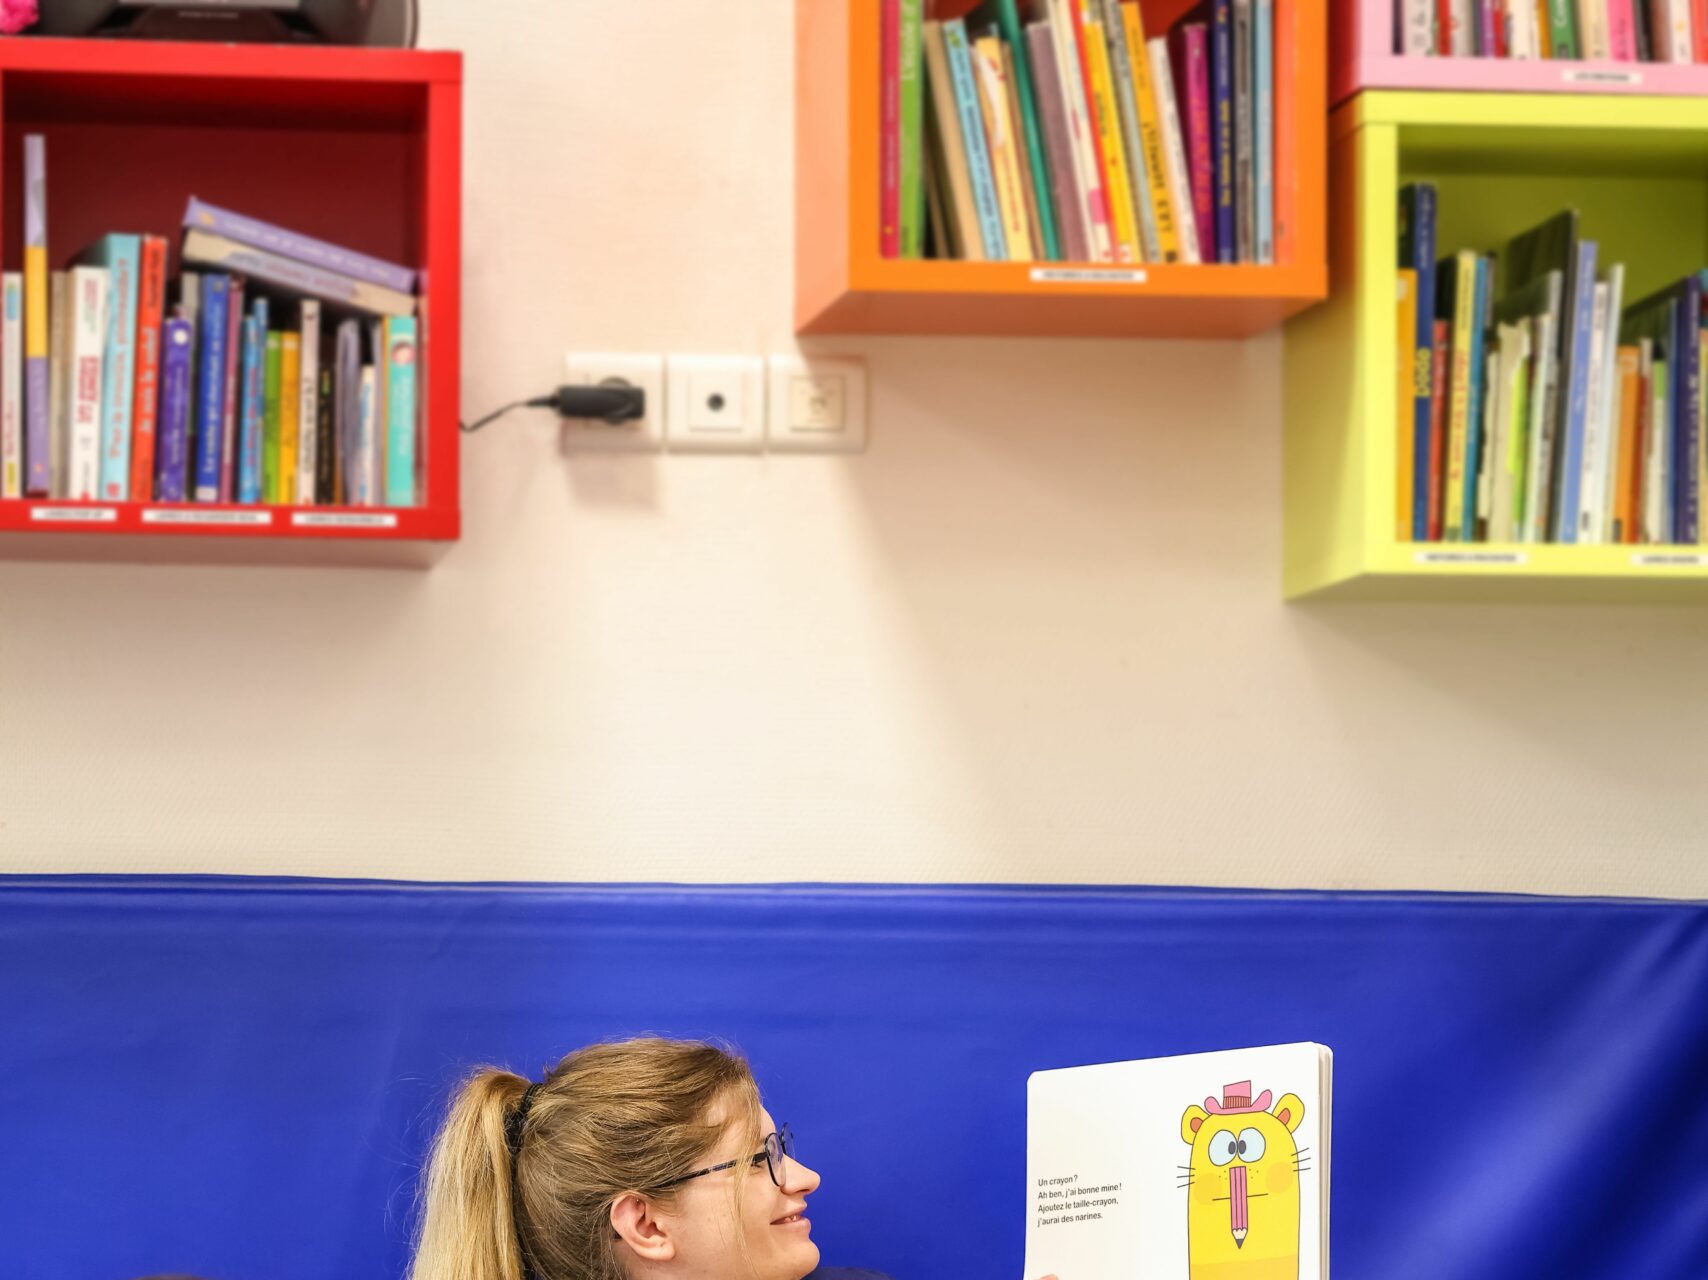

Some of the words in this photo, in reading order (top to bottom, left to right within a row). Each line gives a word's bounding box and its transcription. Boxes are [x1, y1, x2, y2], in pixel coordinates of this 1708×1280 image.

[1038, 1178, 1048, 1187] Un
[1038, 1191, 1048, 1200] Ah
[1049, 1190, 1064, 1198] ben,
[1065, 1187, 1077, 1199] j'ai
[1077, 1186, 1099, 1195] bonne
[1038, 1203, 1064, 1214] Ajoutez
[1065, 1201, 1072, 1209] le
[1073, 1197, 1119, 1209] taille-crayon,
[1037, 1215, 1060, 1228] j'aurai
[1061, 1215, 1074, 1223] des
[1075, 1212, 1103, 1221] narines.
